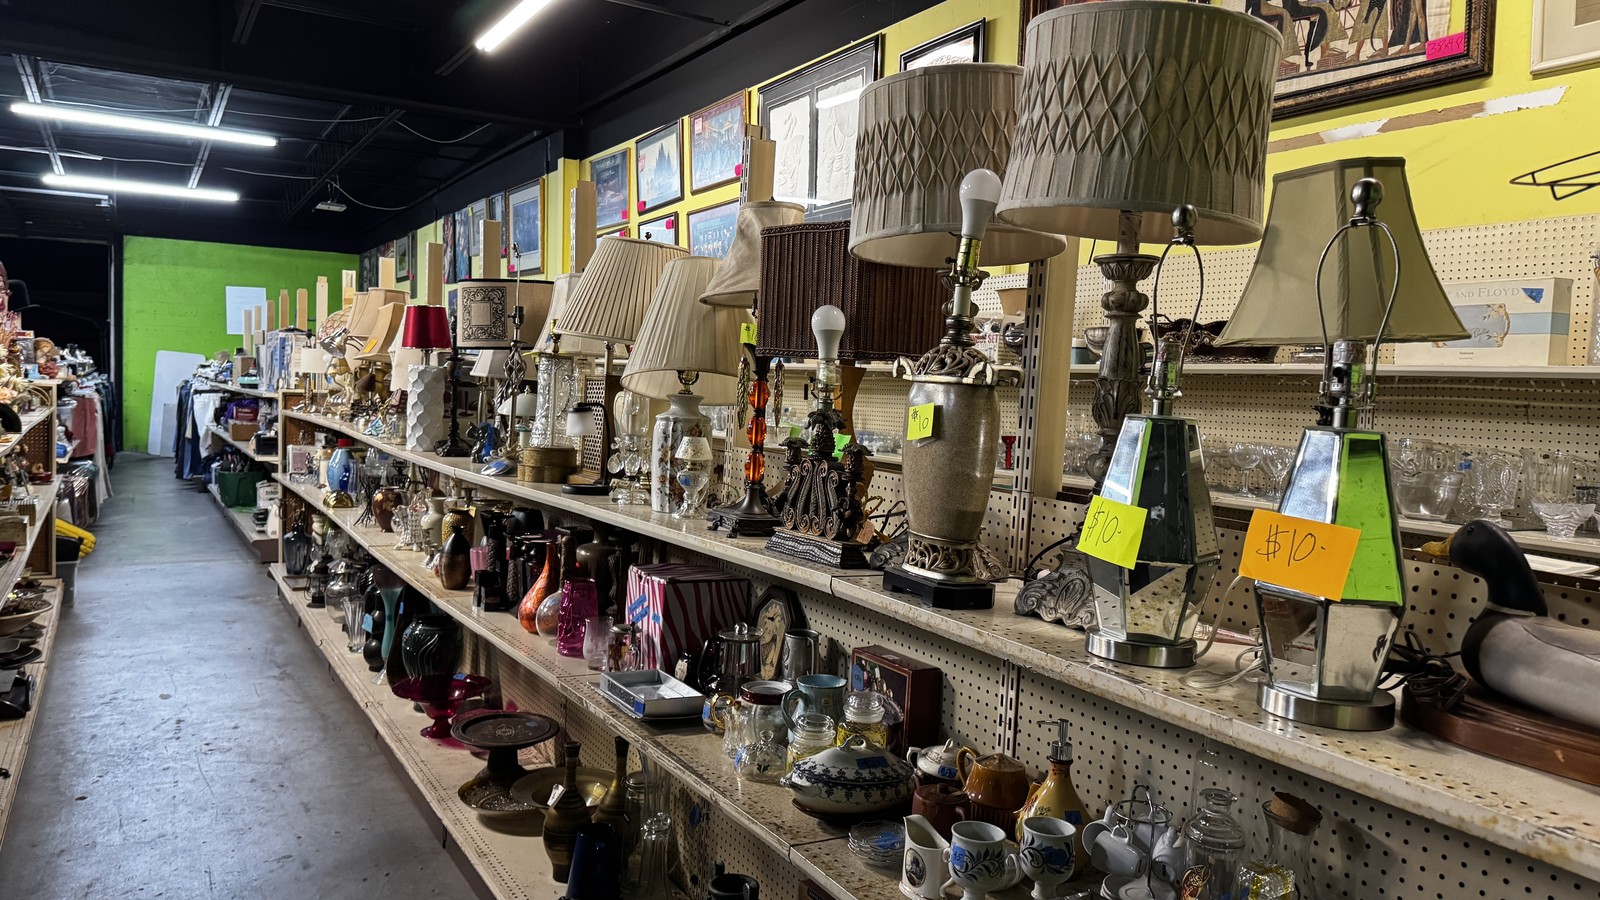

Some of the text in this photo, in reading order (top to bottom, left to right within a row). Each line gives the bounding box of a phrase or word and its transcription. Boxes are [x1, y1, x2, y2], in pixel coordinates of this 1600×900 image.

[1455, 291, 1474, 299] AND
[1478, 287, 1520, 298] FLOYD
[987, 334, 999, 344] SET
[910, 407, 930, 432] $10
